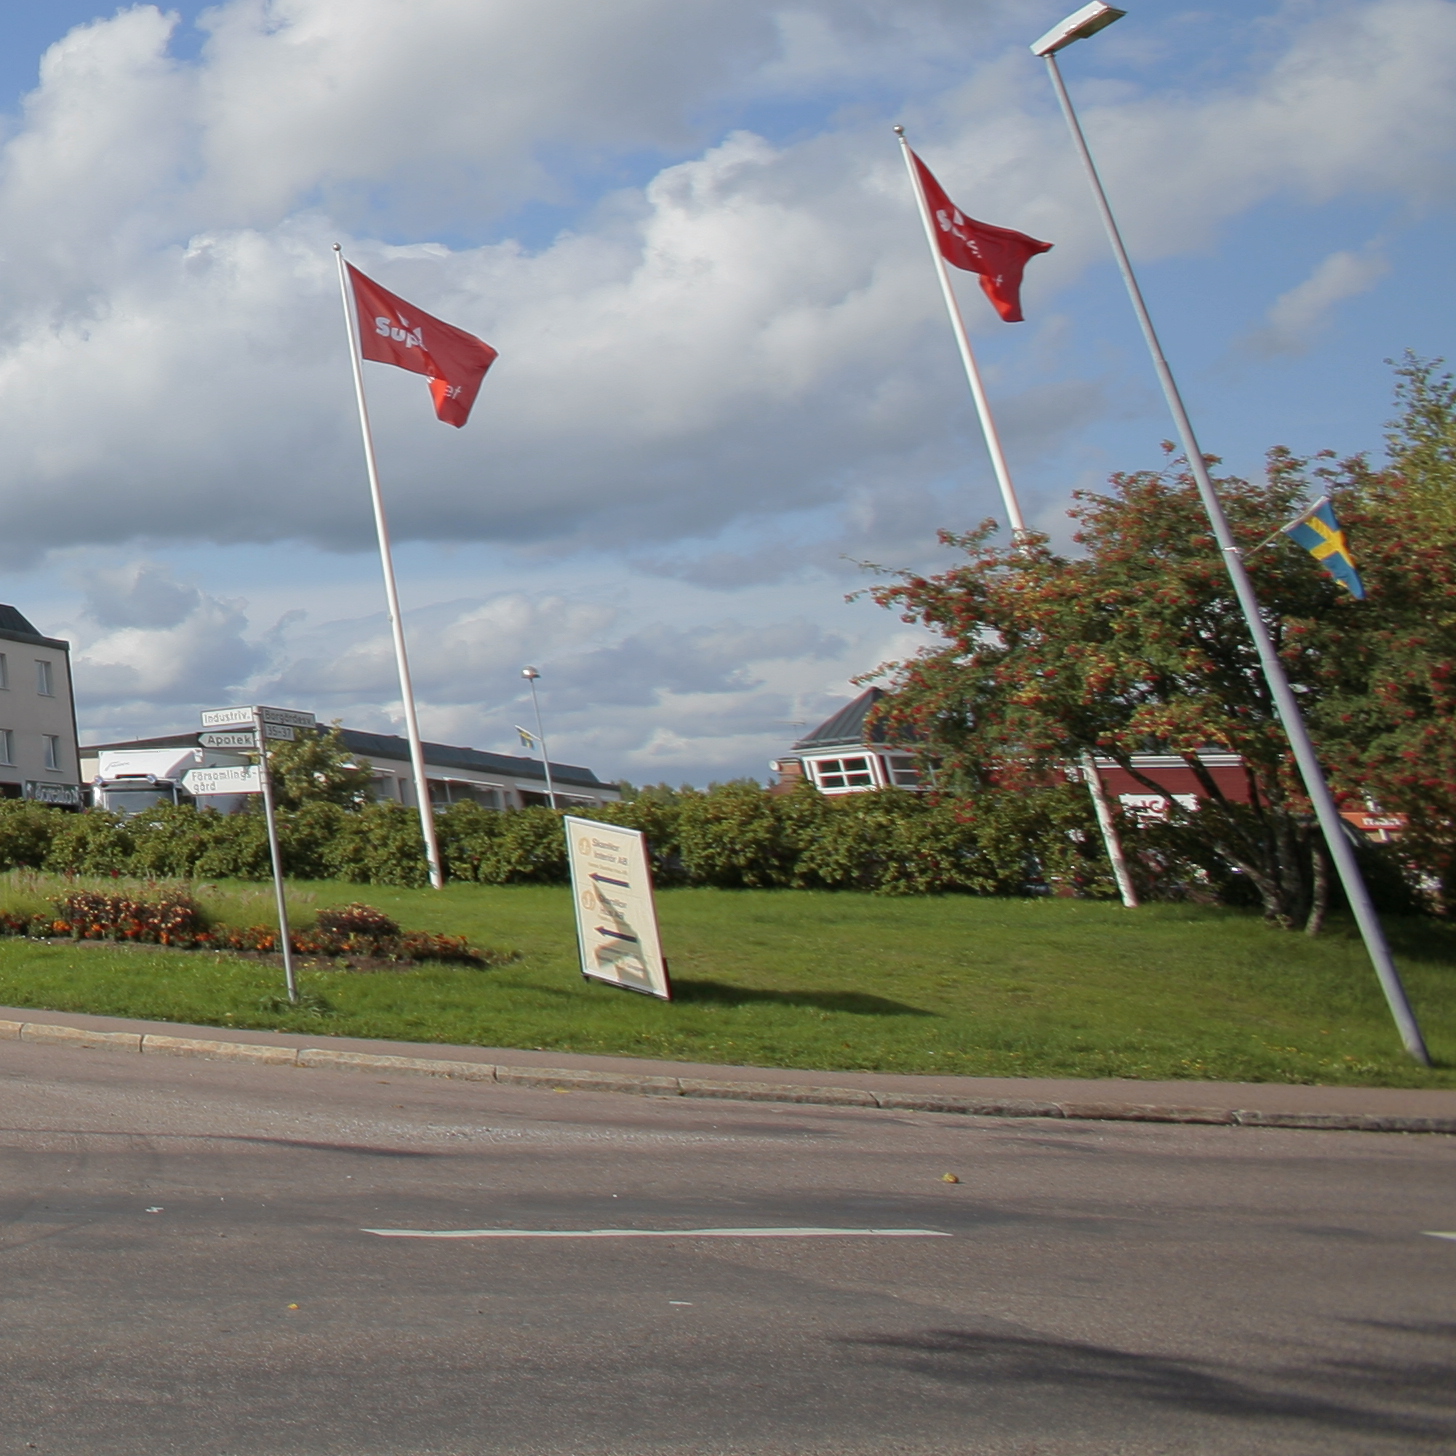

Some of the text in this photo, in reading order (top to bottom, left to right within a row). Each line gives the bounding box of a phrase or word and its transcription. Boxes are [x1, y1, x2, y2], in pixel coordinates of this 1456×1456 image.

[204, 710, 251, 724] Industriv.
[208, 735, 251, 746] Apotek
[193, 782, 216, 794] gård
